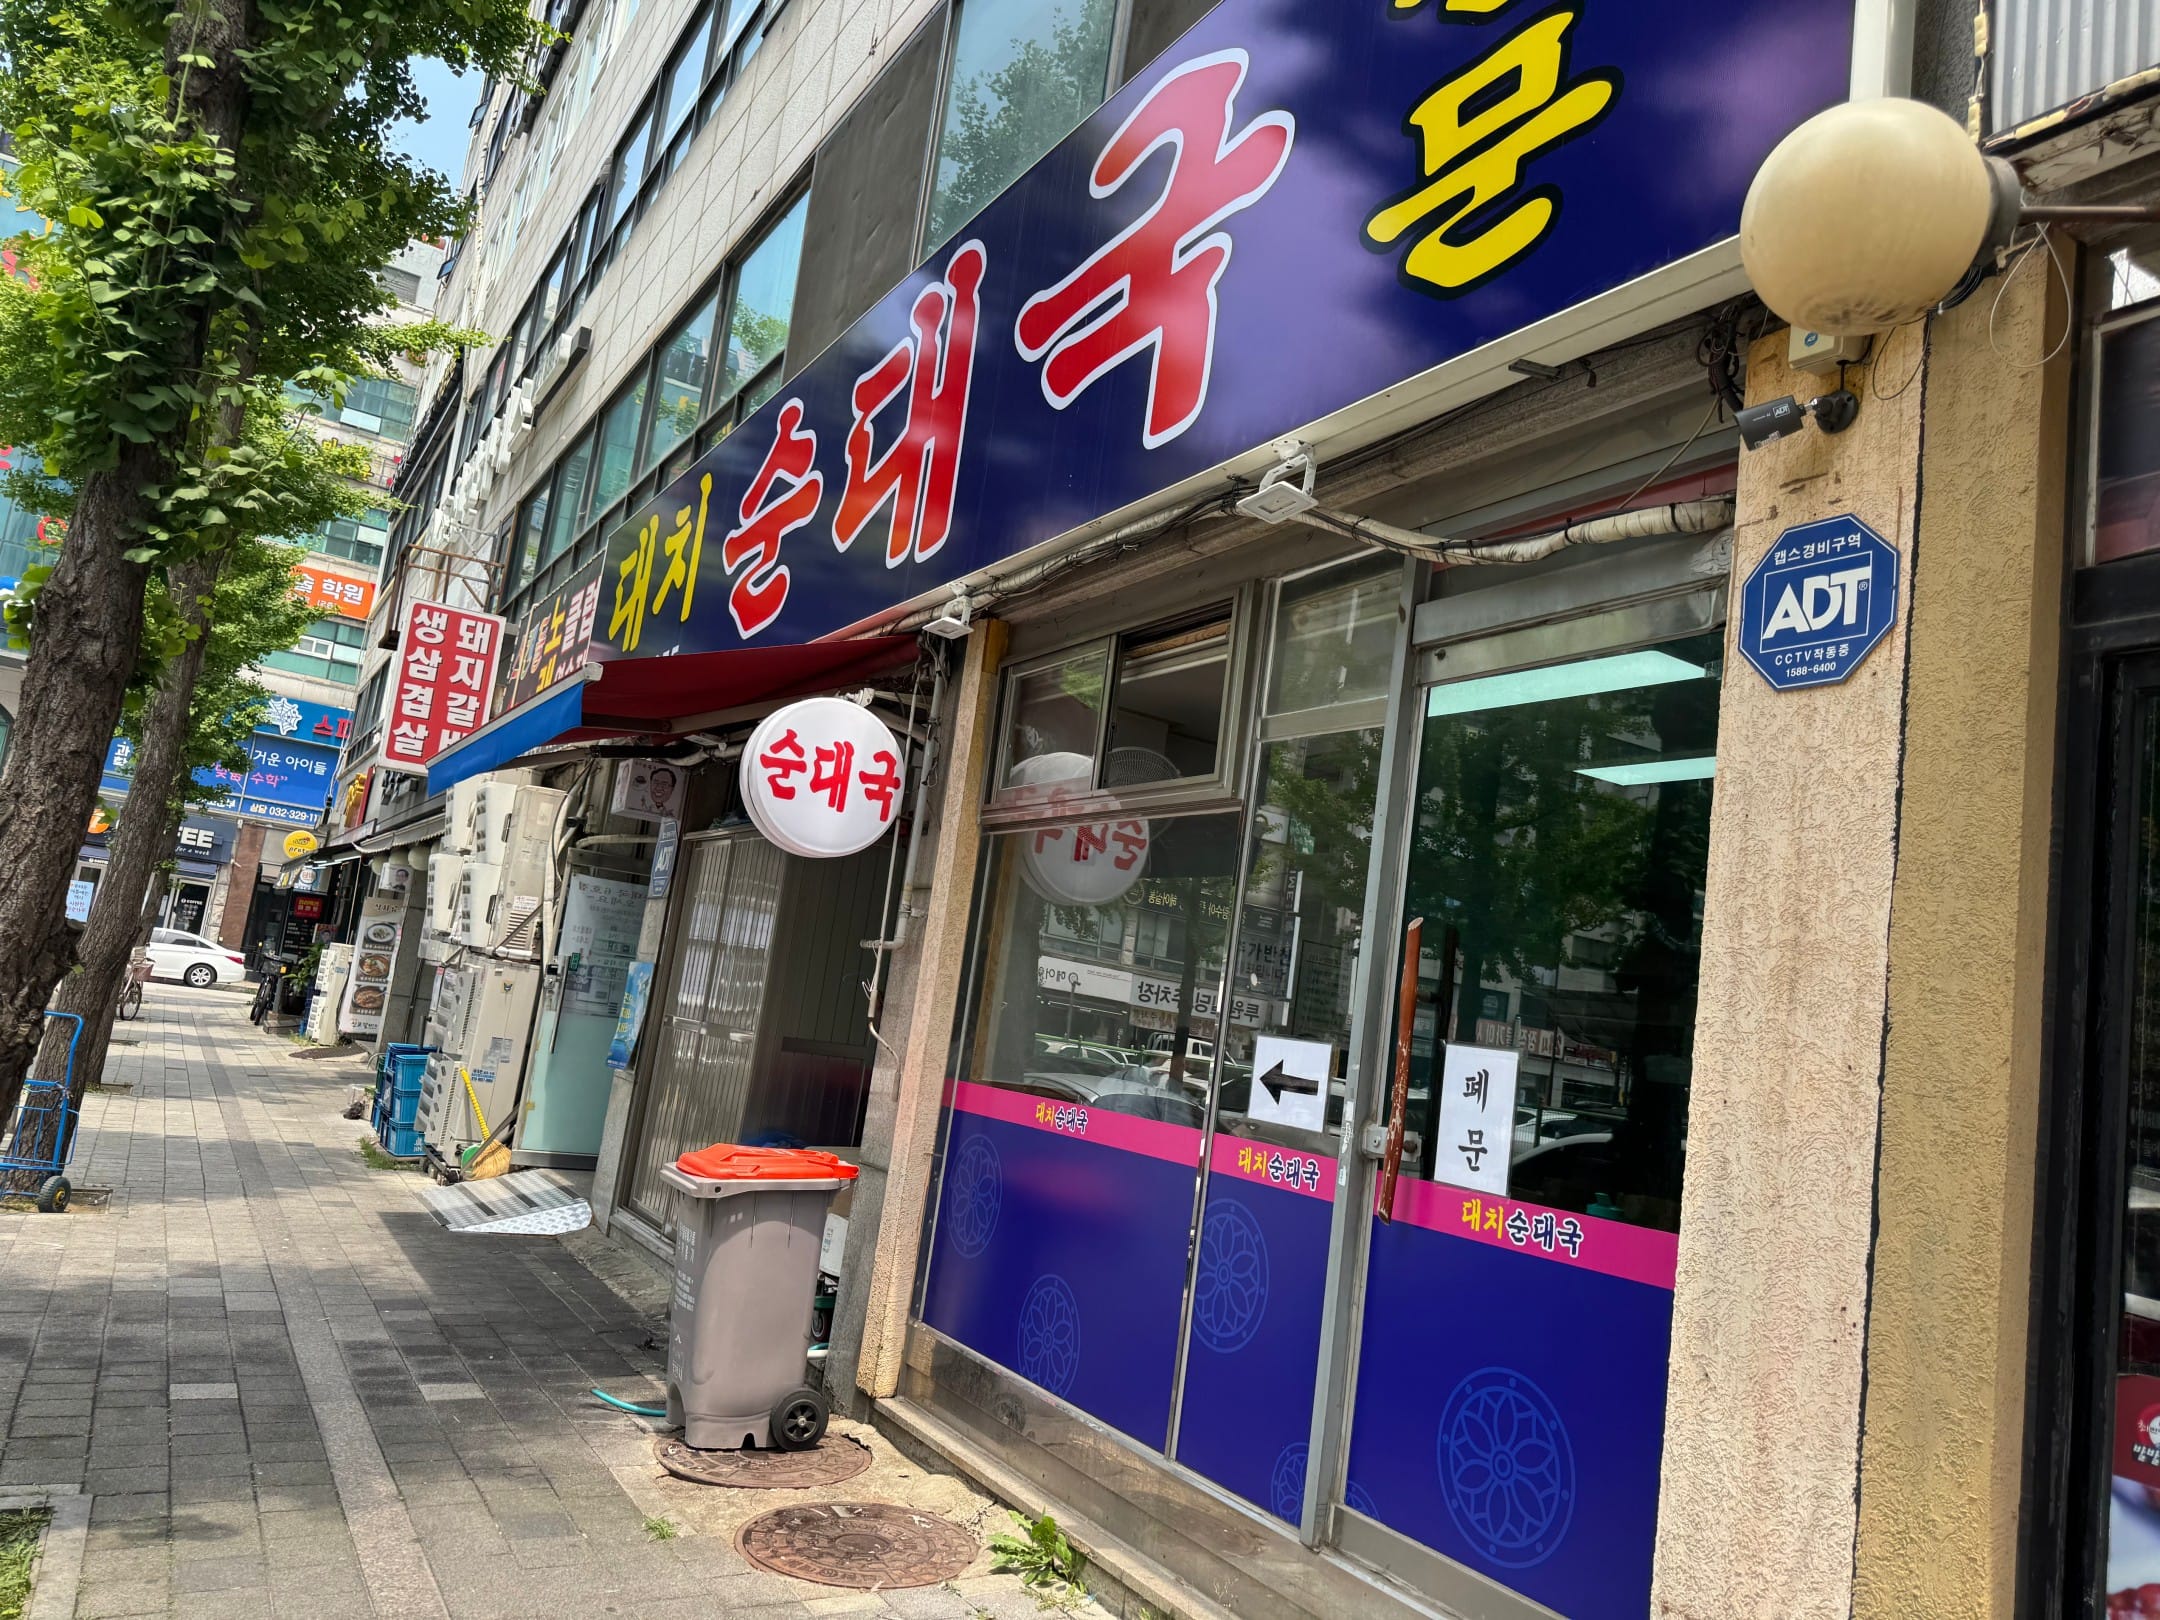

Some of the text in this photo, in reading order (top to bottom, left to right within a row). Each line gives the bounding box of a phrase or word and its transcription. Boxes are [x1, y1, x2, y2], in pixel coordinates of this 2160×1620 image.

[1366, 0, 1613, 288] 문
[608, 47, 1295, 652] 대치 순대국
[1775, 403, 1790, 416] ADT
[1773, 532, 1862, 565] 캡스경비구역
[322, 579, 364, 605] 학원
[1762, 566, 1871, 640] ADT
[1775, 643, 1850, 667] CCTV작동중
[1785, 661, 1837, 678] 1588-6400
[392, 607, 448, 757] 생삼겹살
[285, 756, 327, 776] 아이들
[759, 728, 901, 822] 순대국
[177, 825, 215, 849] EE
[1036, 1101, 1088, 1134] 대치순대국
[1457, 1069, 1489, 1171] 폐문
[1238, 1147, 1320, 1191] 대치순대국
[1461, 1198, 1584, 1258] 대치순대국
